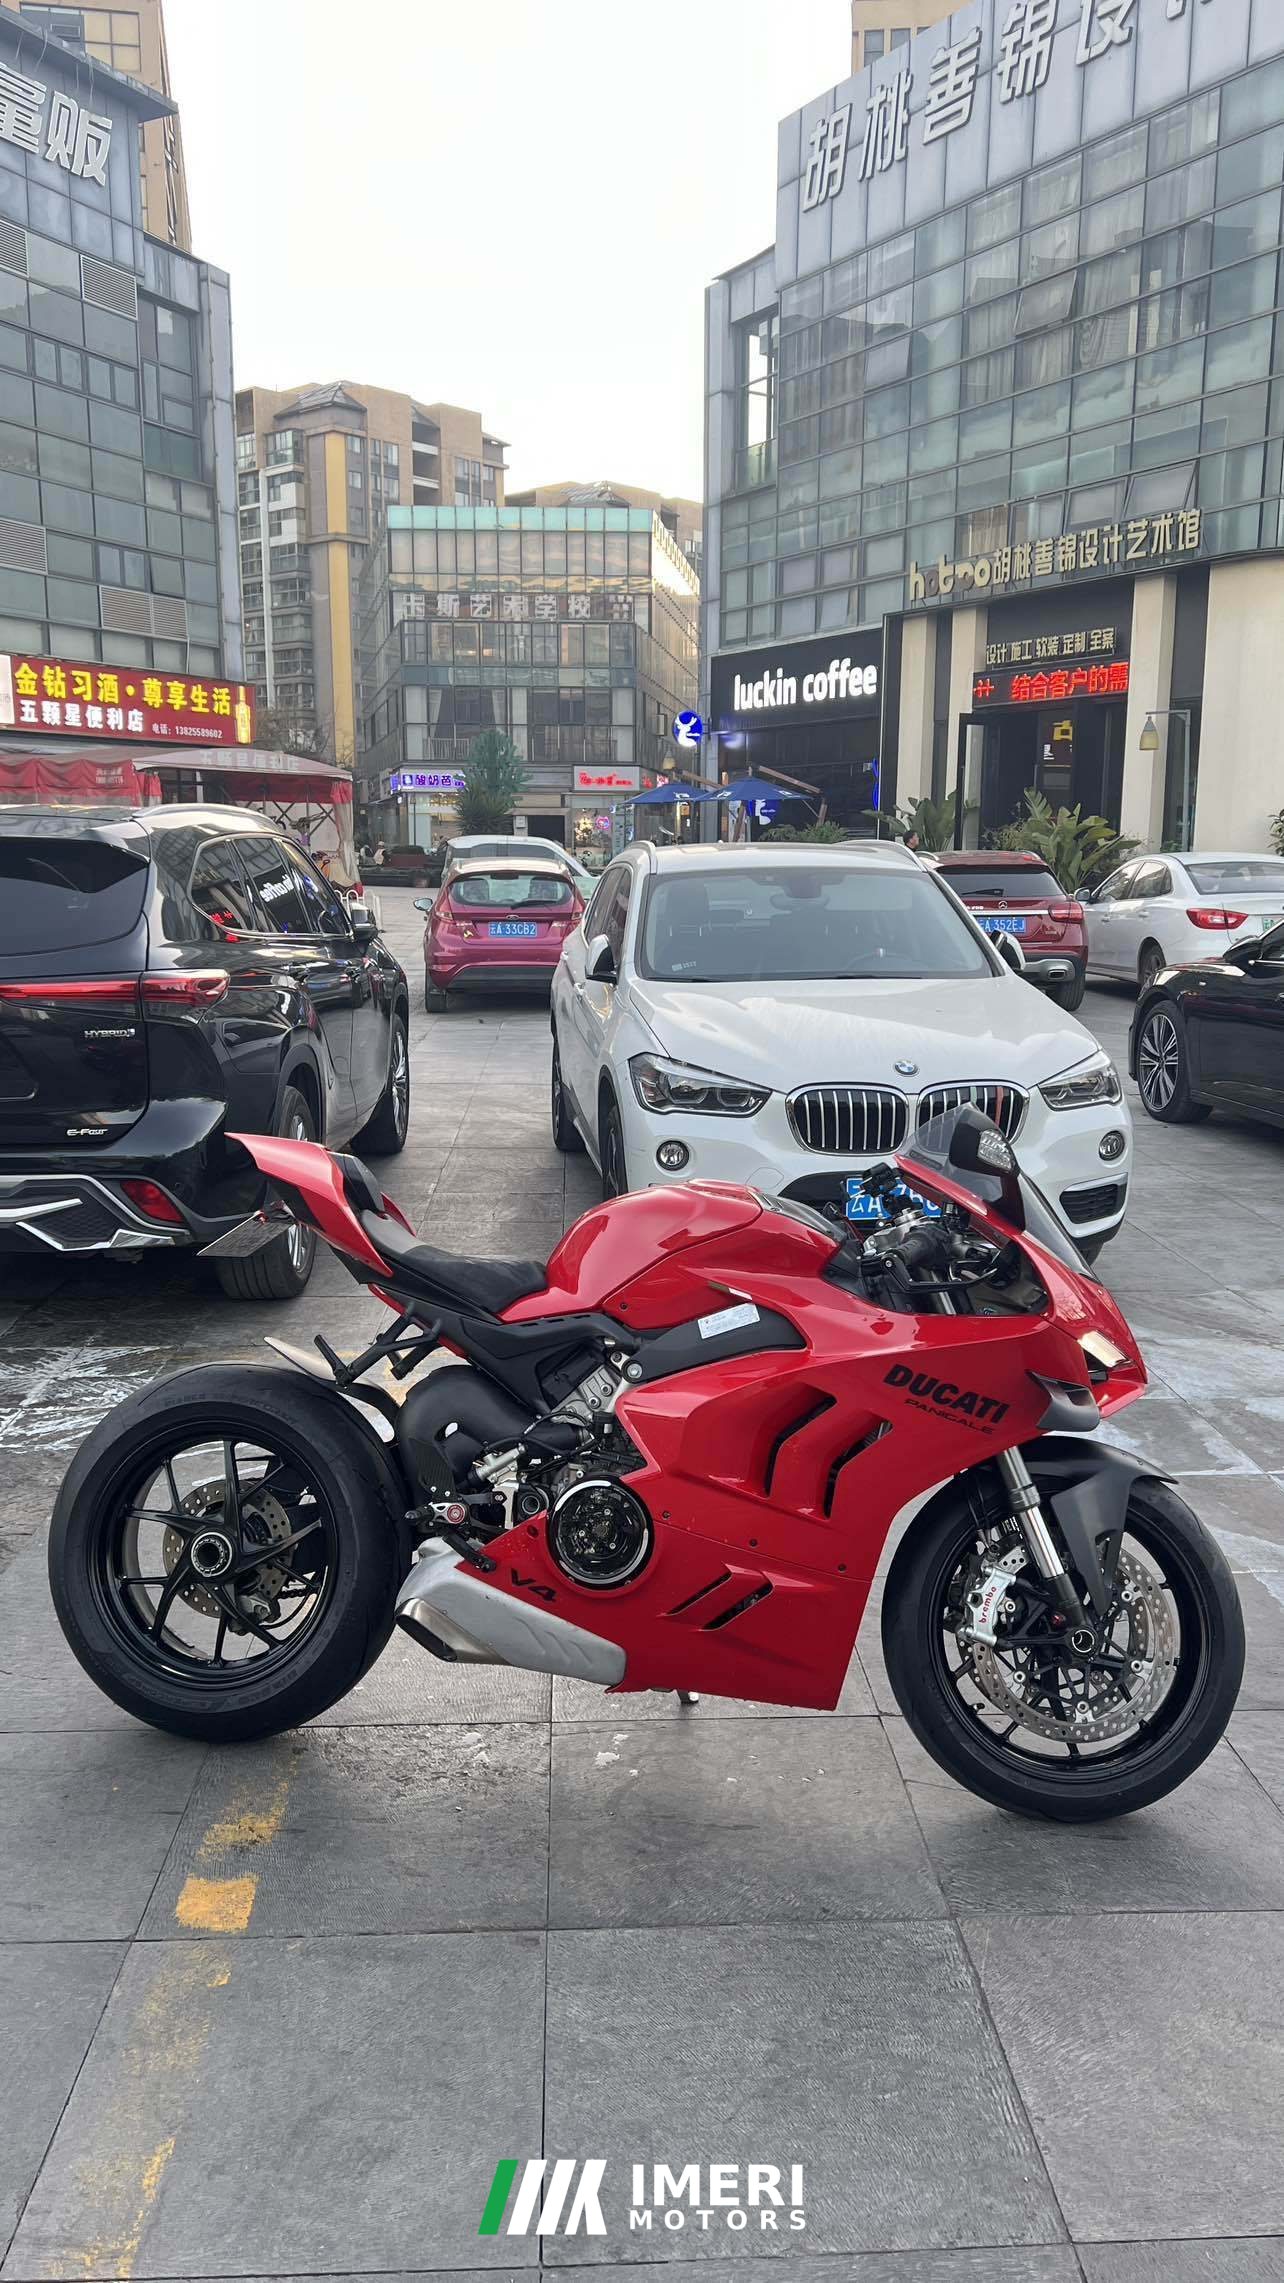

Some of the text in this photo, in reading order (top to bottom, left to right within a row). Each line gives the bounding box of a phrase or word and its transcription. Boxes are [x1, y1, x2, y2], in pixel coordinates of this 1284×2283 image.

[993, 508, 1202, 584] 胡桃善锦设计艺术馆
[986, 628, 1114, 665] 设计 施工 软装 定制 全案
[14, 662, 231, 716] 金钻习酒·尊享生活
[734, 657, 878, 711] luckin coffee
[1011, 661, 1129, 700] 结合客户的需
[20, 699, 144, 733] 五颗星便利店
[883, 1363, 1010, 1424] DUCATI
[511, 1567, 557, 1603] V4
[979, 1586, 997, 1623] brembo
